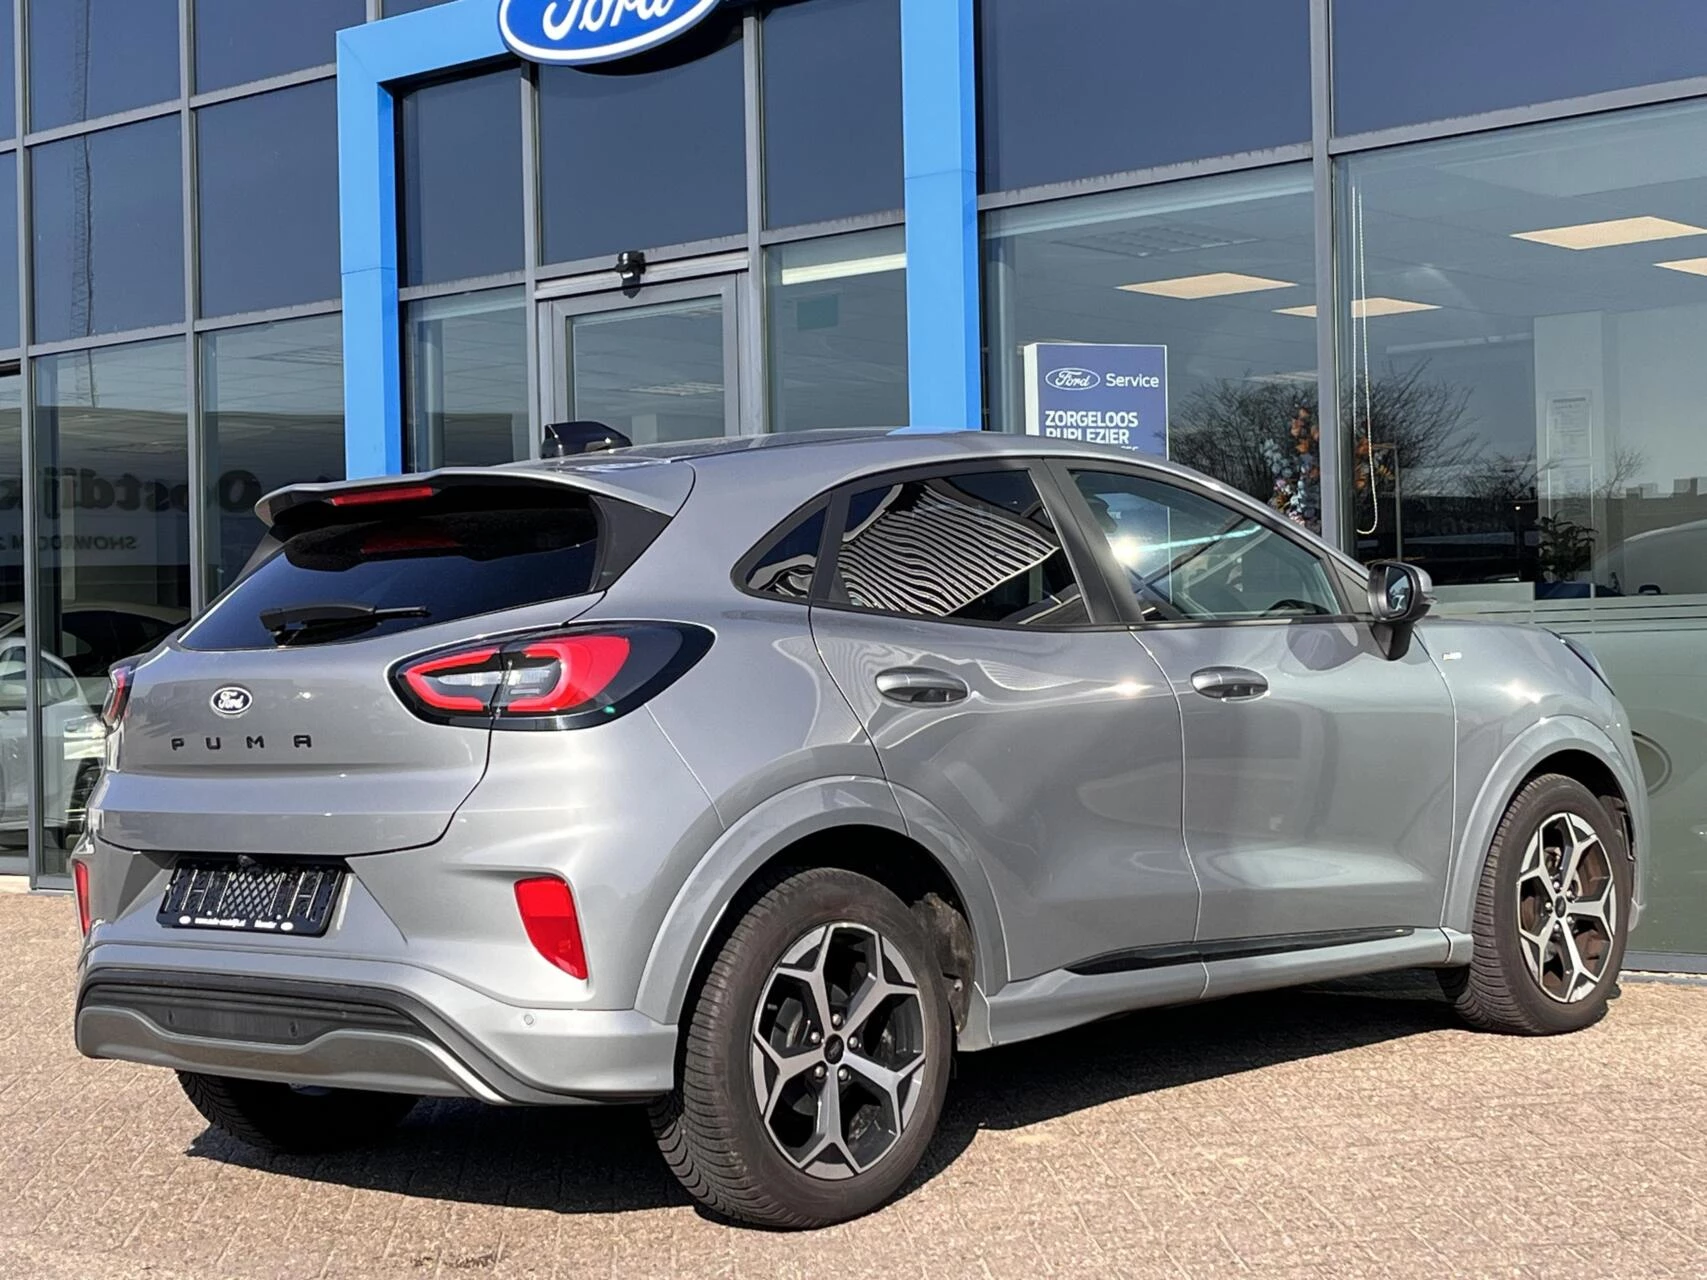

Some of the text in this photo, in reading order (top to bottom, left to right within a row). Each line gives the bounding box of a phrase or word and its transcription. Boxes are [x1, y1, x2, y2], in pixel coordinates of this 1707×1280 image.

[1054, 369, 1160, 388] Ford Service
[1045, 410, 1139, 427] ZORGELOOS
[218, 691, 244, 709] Ford
[171, 735, 312, 751] PUMA
